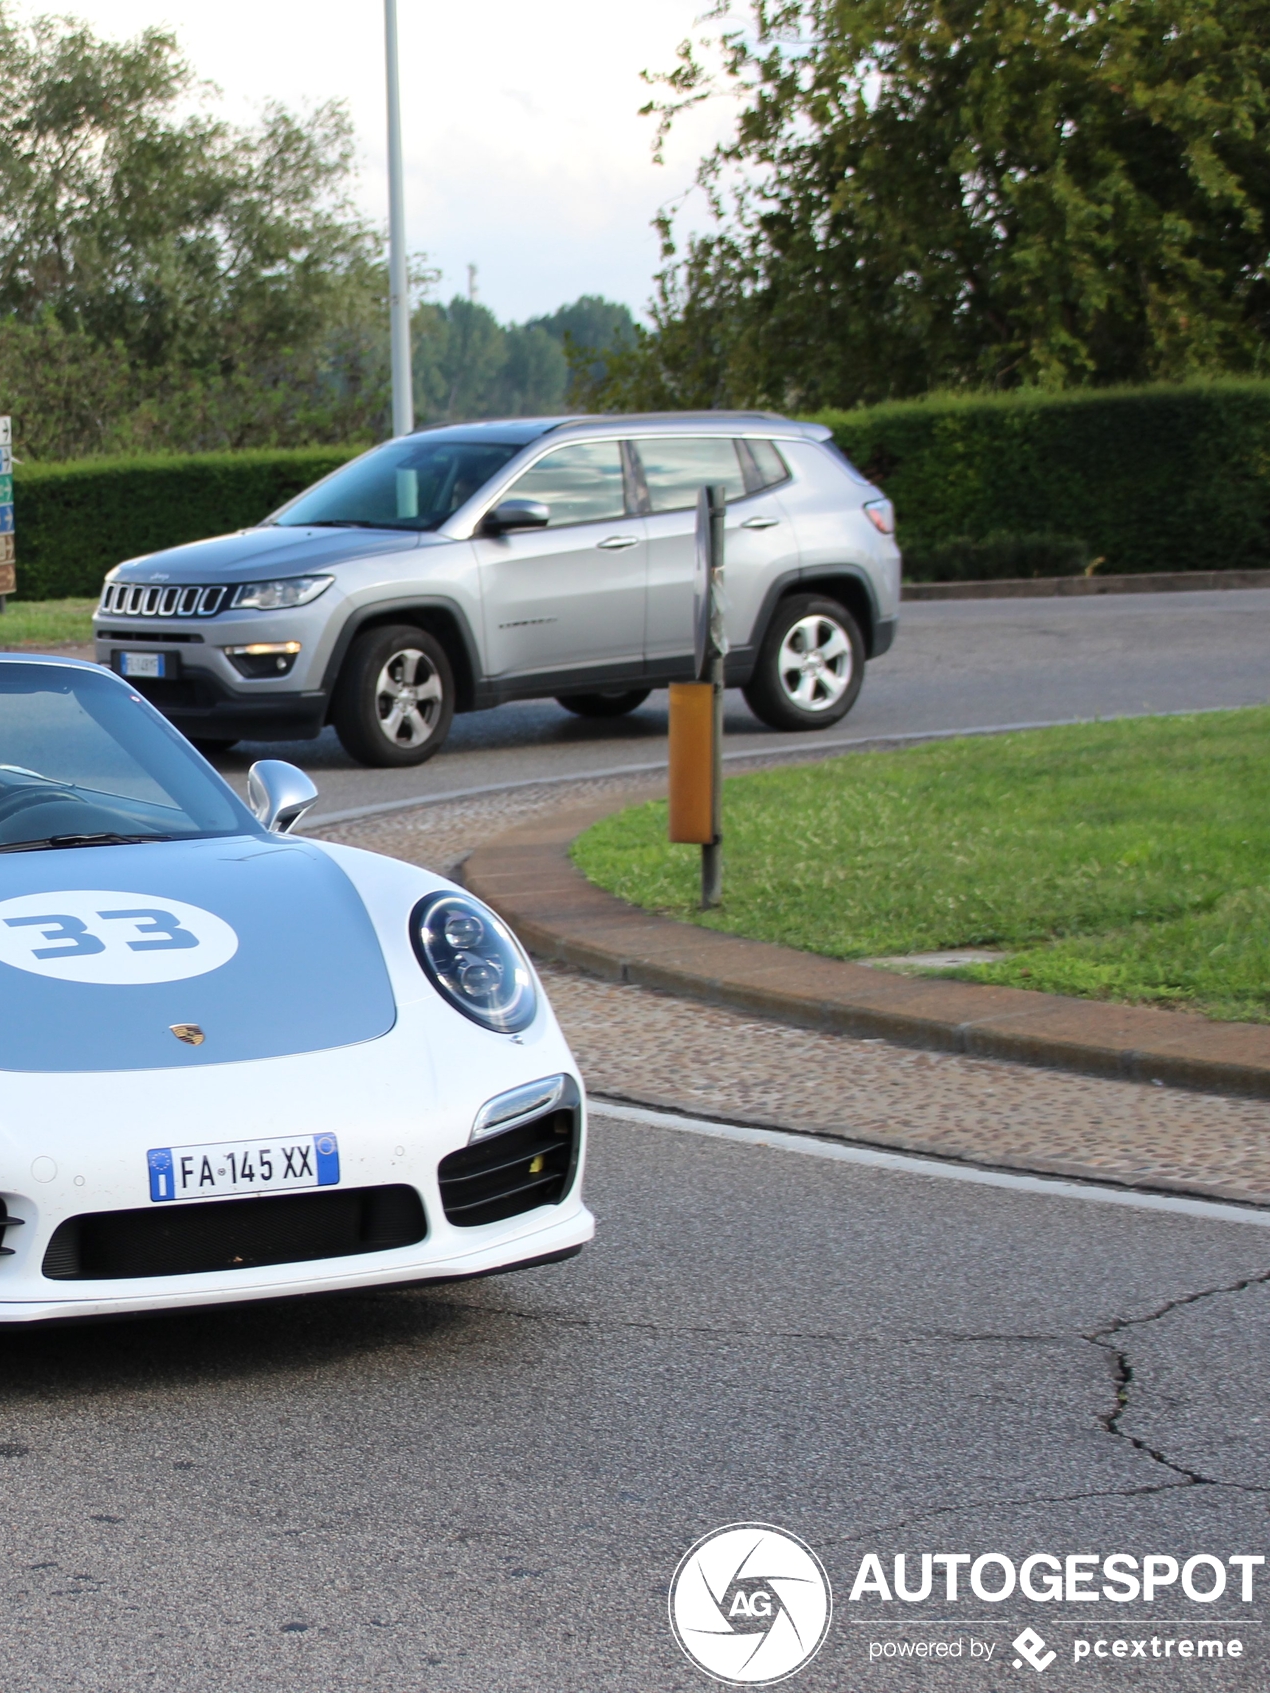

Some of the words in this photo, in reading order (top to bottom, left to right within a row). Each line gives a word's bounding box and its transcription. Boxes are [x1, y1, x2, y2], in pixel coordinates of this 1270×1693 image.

[2, 909, 200, 960] 33
[180, 1155, 215, 1188] FA
[281, 1145, 313, 1179] XX
